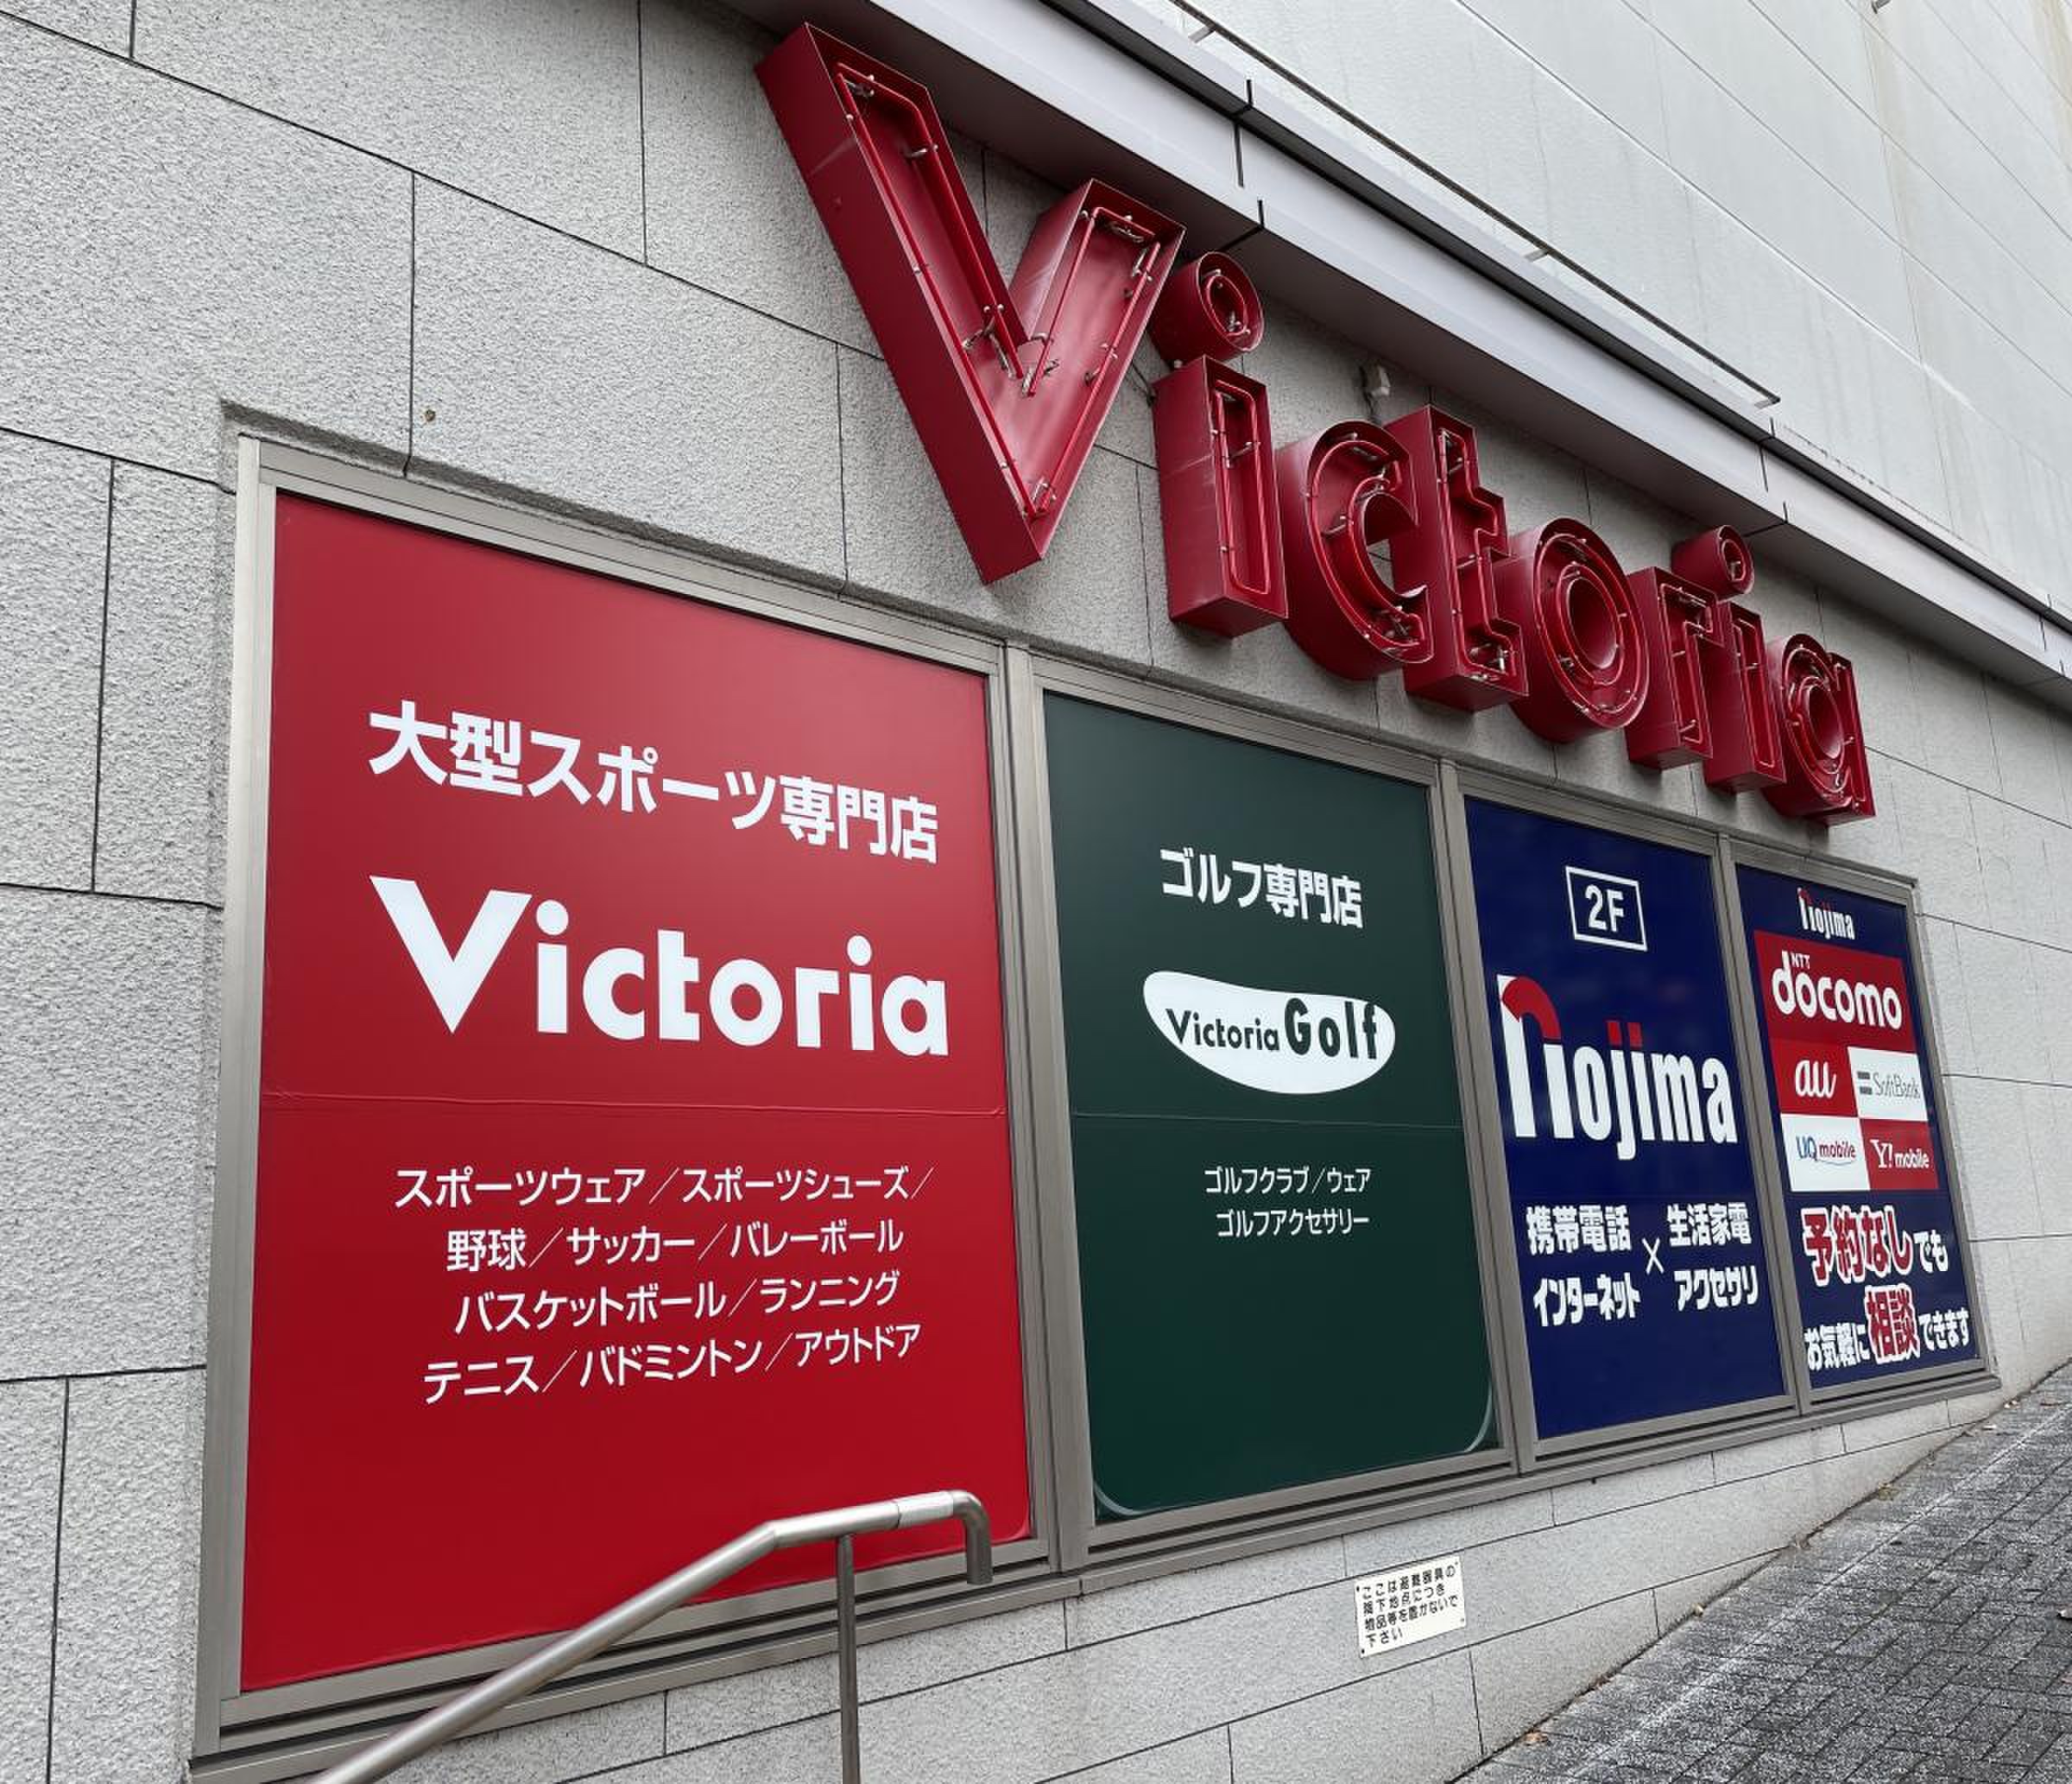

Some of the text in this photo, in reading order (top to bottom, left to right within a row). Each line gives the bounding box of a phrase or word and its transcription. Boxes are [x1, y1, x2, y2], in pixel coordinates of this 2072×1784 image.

[756, 23, 1876, 826] Victoria
[369, 699, 938, 864] 大型スポーツ専門店
[1160, 847, 1363, 928] ゴルフ専門店
[1585, 883, 1625, 932] 2F
[369, 875, 949, 1056] Victoria
[1772, 950, 1902, 1029] docomo
[1791, 952, 1810, 969] NTT
[1165, 997, 1378, 1060] Victoria Golf
[1497, 974, 1738, 1160] nojima
[1794, 1060, 1836, 1098] au
[1796, 1136, 1855, 1161] UQ mobile
[1216, 1208, 1370, 1237] ゴルフアクセサリー
[1526, 1205, 1632, 1256] 携帯電話
[1666, 1202, 1753, 1247] 生活家電
[1801, 1205, 1949, 1287] 予約なしでも
[1533, 1272, 1640, 1326] インターネット
[1674, 1265, 1759, 1312] アクセサリ
[1804, 1282, 1970, 1371] お気軽に相談できます
